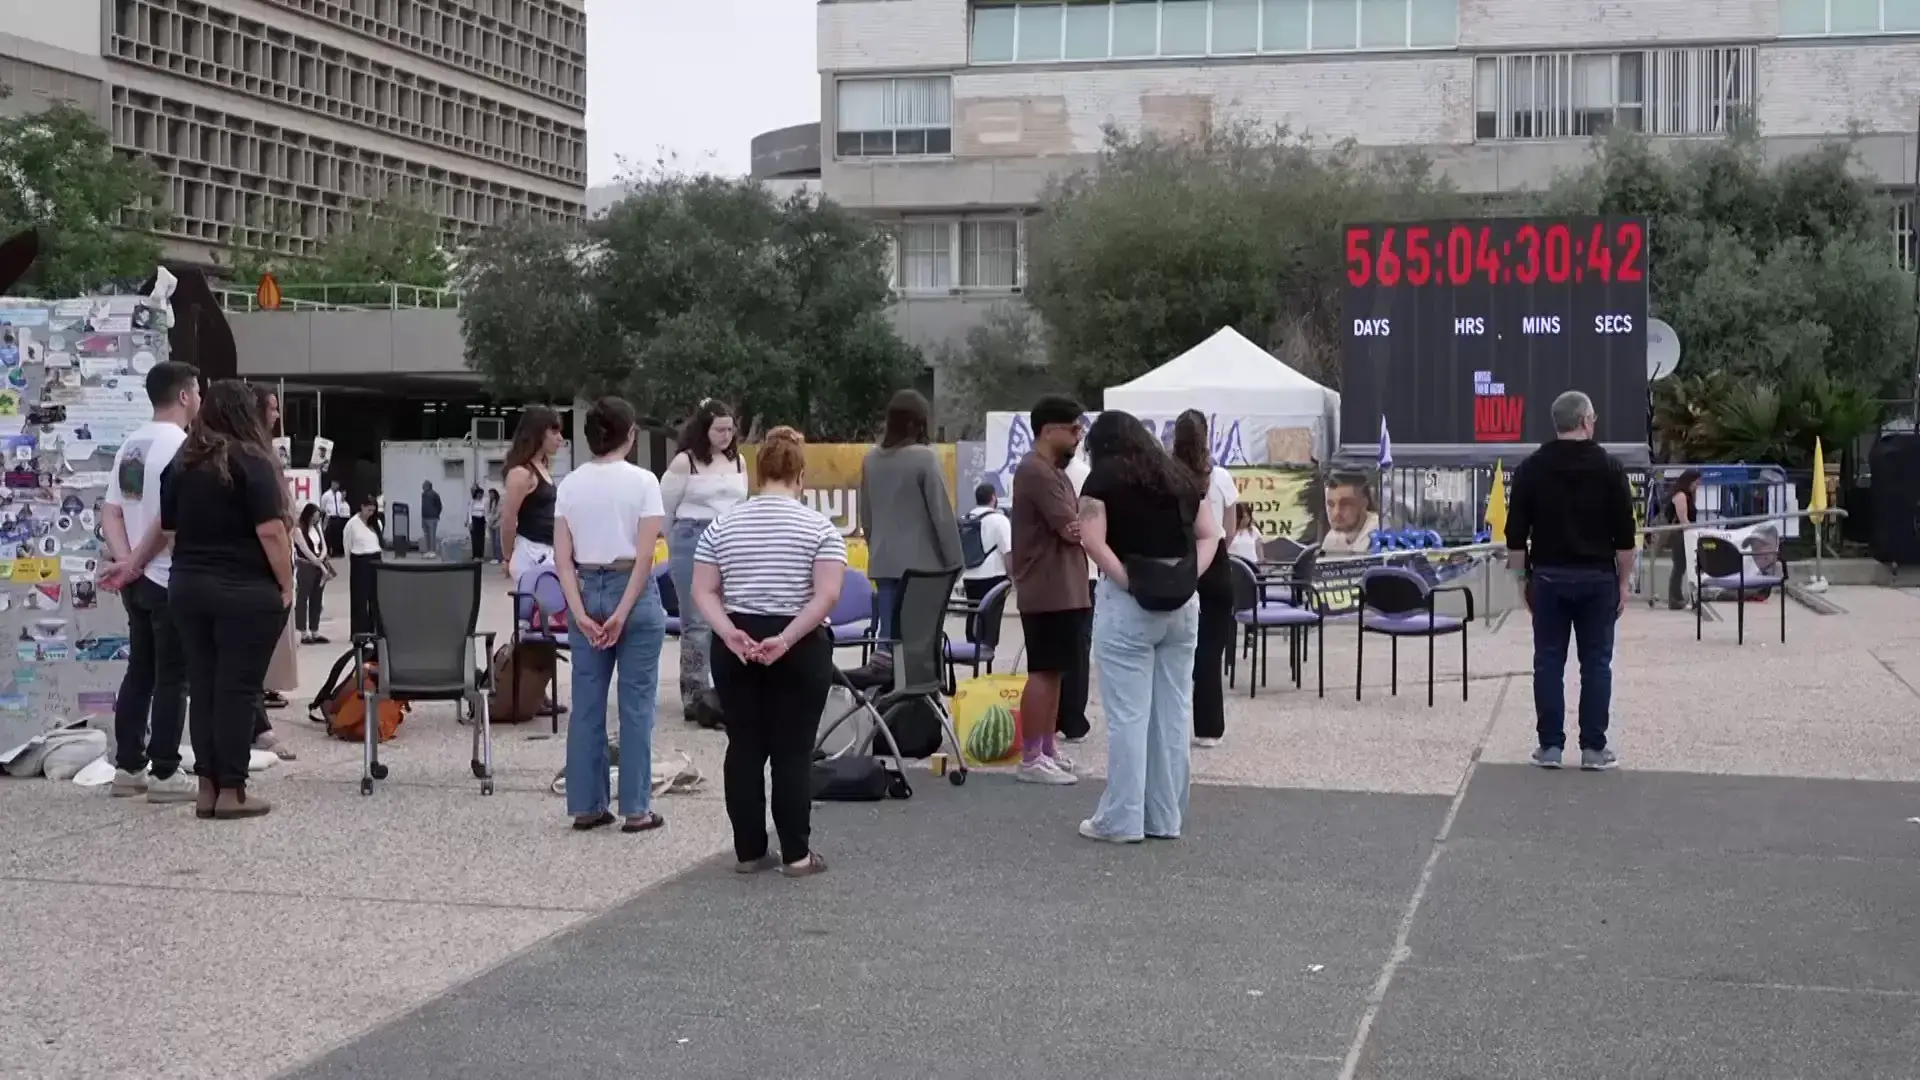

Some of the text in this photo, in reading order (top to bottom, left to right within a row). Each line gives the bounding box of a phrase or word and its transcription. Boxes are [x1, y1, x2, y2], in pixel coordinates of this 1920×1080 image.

[1346, 221, 1643, 287] 565:04:30:42
[1353, 314, 1633, 337] DAYS HRS MINS SECS
[1474, 395, 1524, 433] NOW
[1254, 476, 1276, 490] בר
[1249, 499, 1281, 512] לכבו
